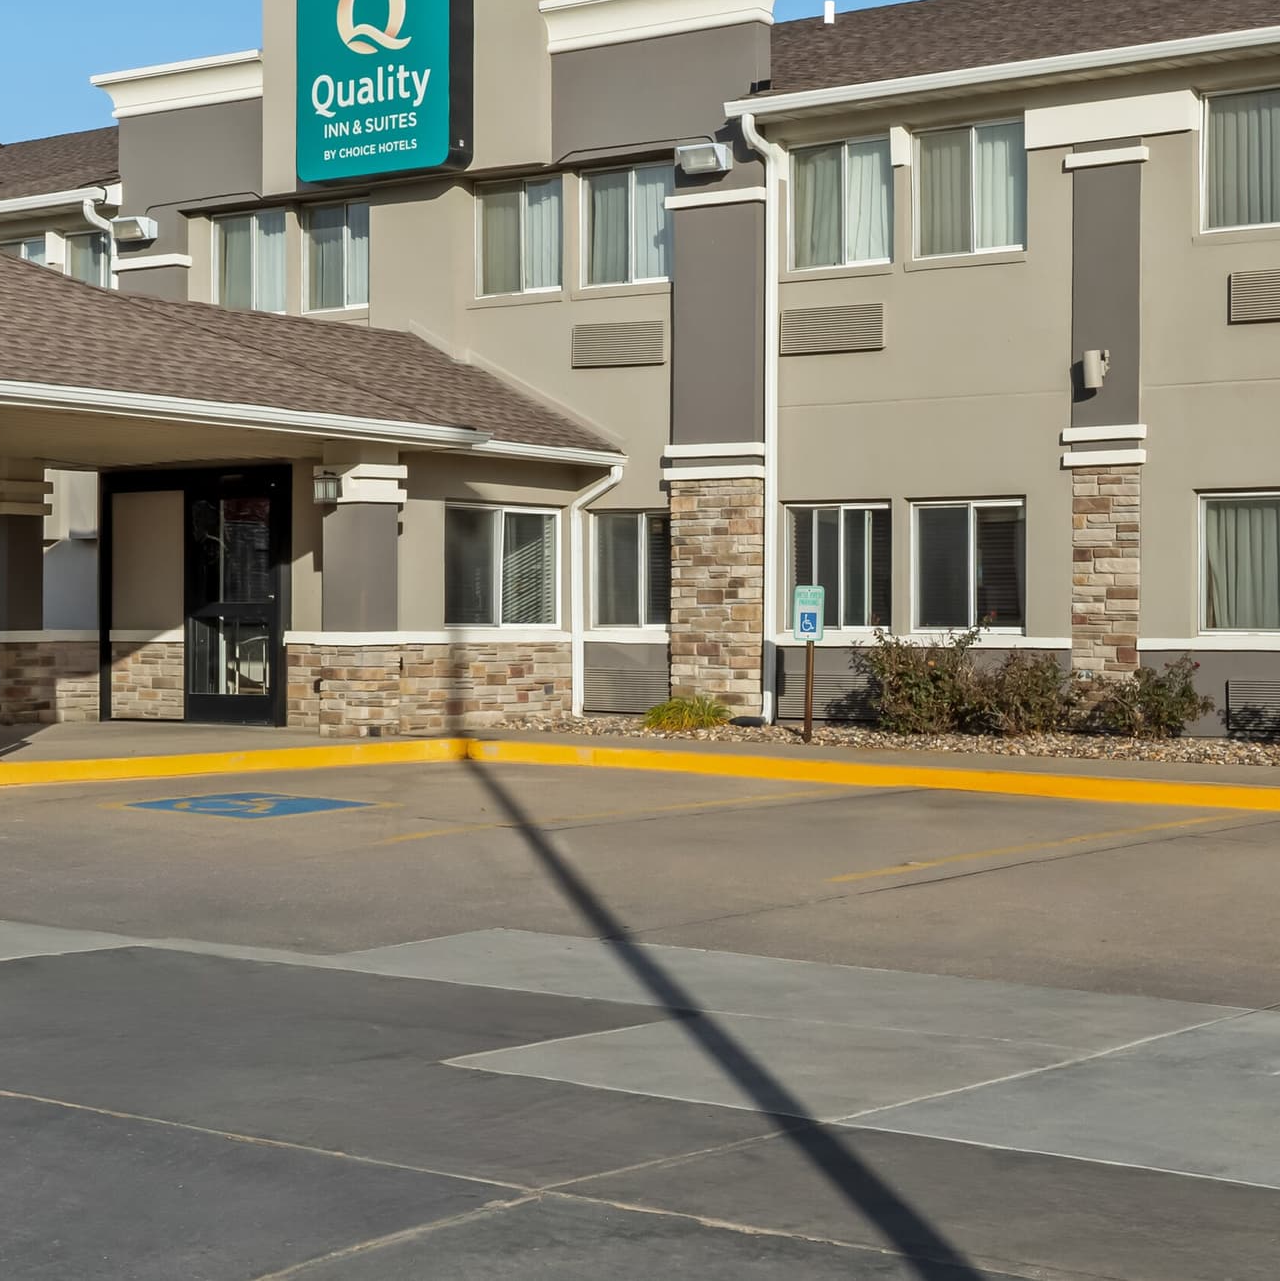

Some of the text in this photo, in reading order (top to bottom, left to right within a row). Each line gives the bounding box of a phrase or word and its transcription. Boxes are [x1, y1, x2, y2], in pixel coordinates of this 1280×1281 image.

[311, 64, 431, 118] Quality
[324, 111, 417, 139] INN & SUITES
[324, 138, 418, 161] BY CHOICE HOTELS
